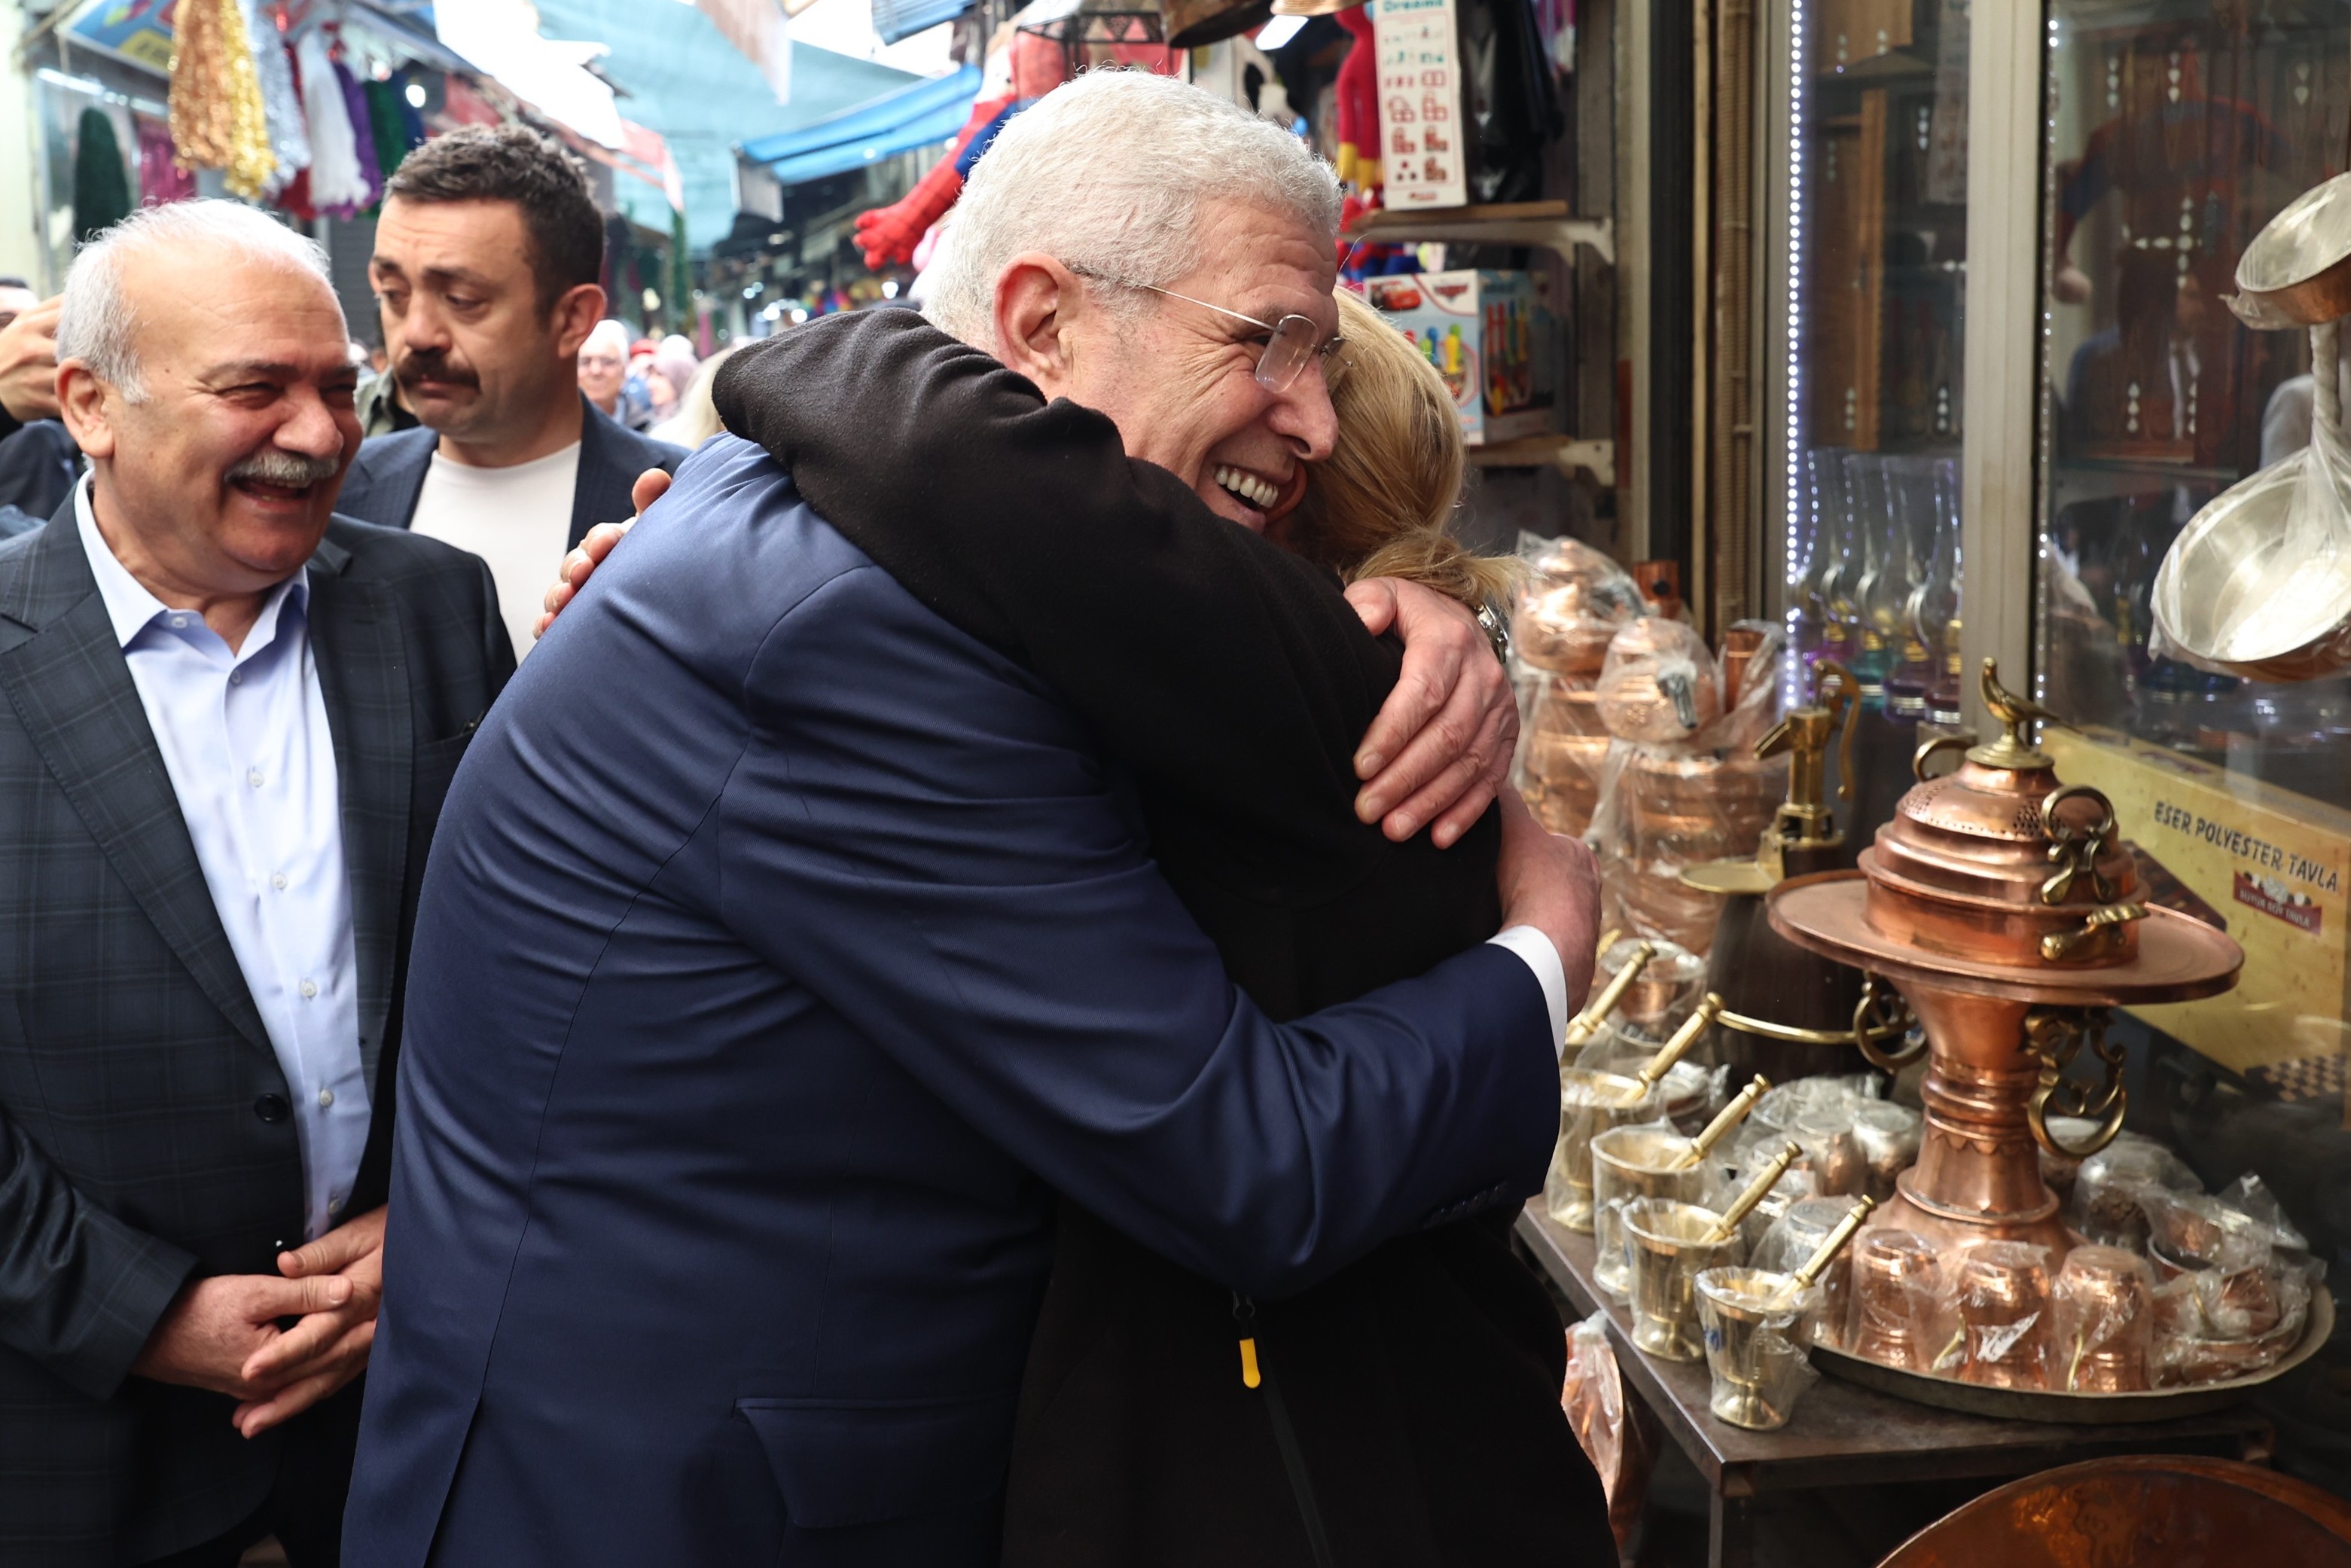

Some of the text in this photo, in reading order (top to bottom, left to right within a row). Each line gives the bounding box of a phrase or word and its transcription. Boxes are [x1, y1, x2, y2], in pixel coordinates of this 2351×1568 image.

[2154, 801, 2338, 892] ESER POLYESTER TAVLA
